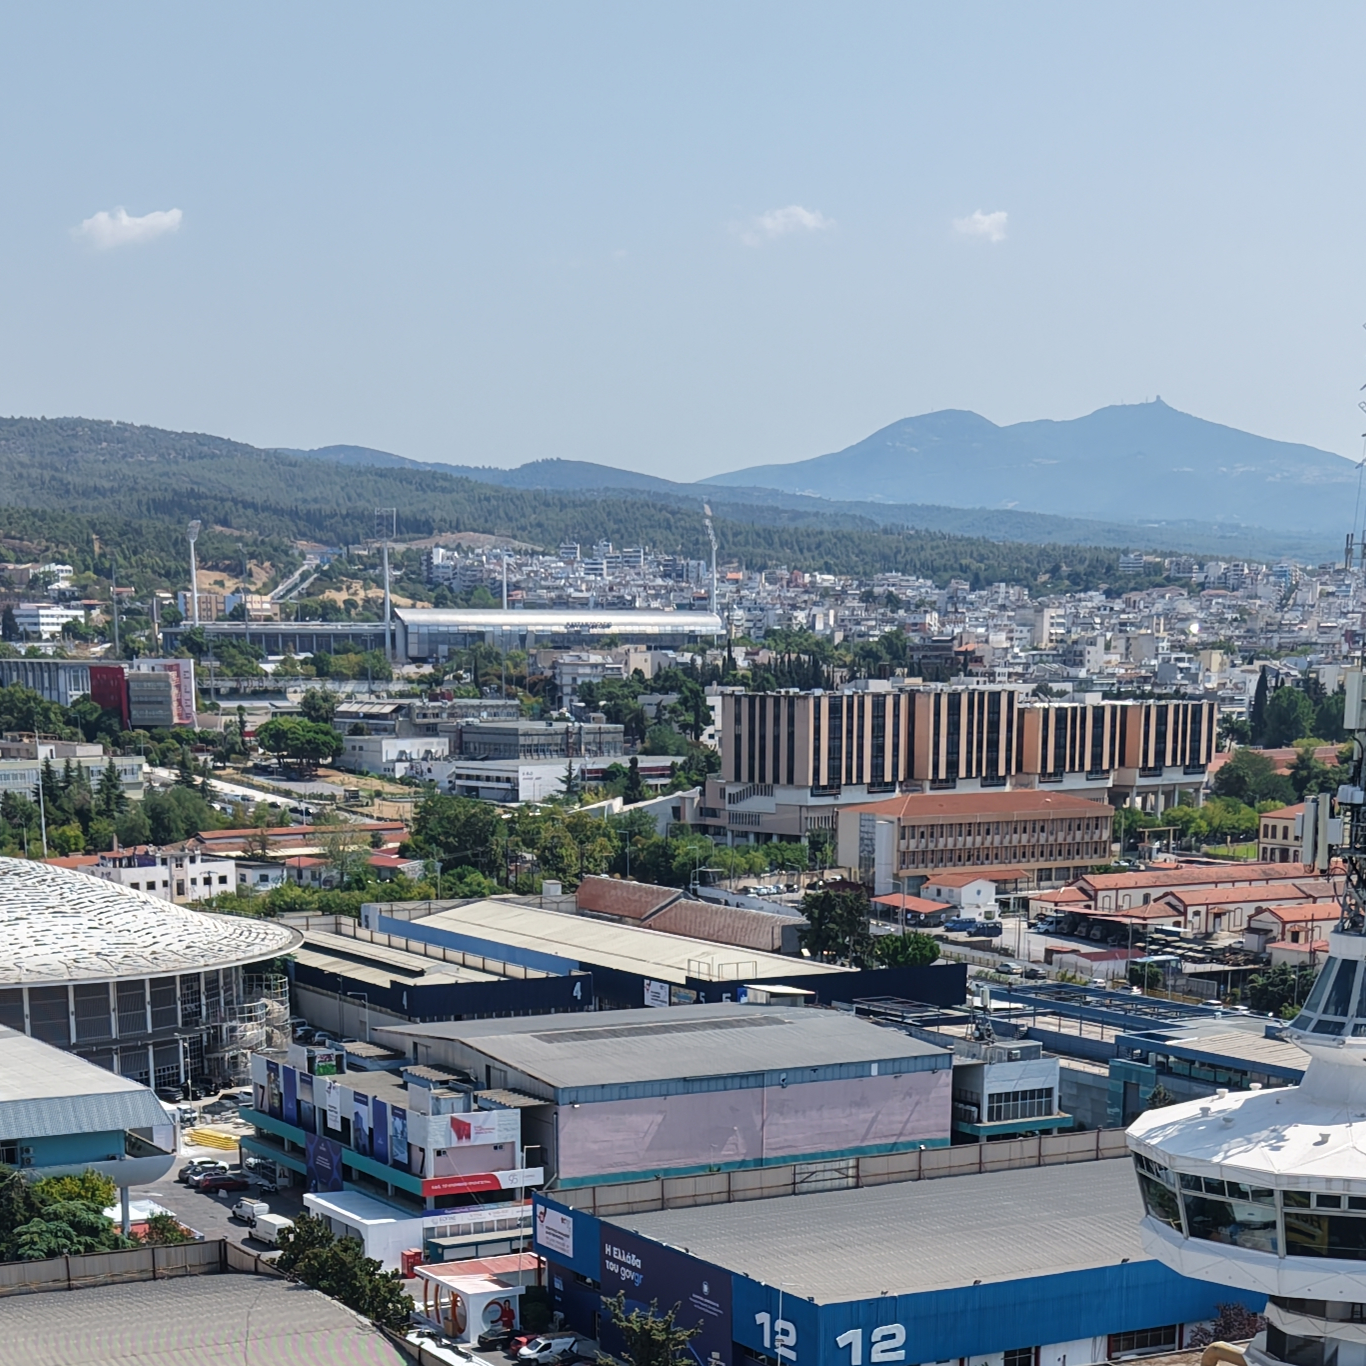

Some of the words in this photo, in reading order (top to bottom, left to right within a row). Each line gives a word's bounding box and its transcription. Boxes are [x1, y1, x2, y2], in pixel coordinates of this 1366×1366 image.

[573, 981, 582, 1000] 4
[605, 1243, 611, 1255] Η
[613, 1246, 642, 1269] Ελλάδα
[605, 1260, 619, 1273] του
[754, 1311, 797, 1362] 12
[836, 1323, 907, 1366] 12
